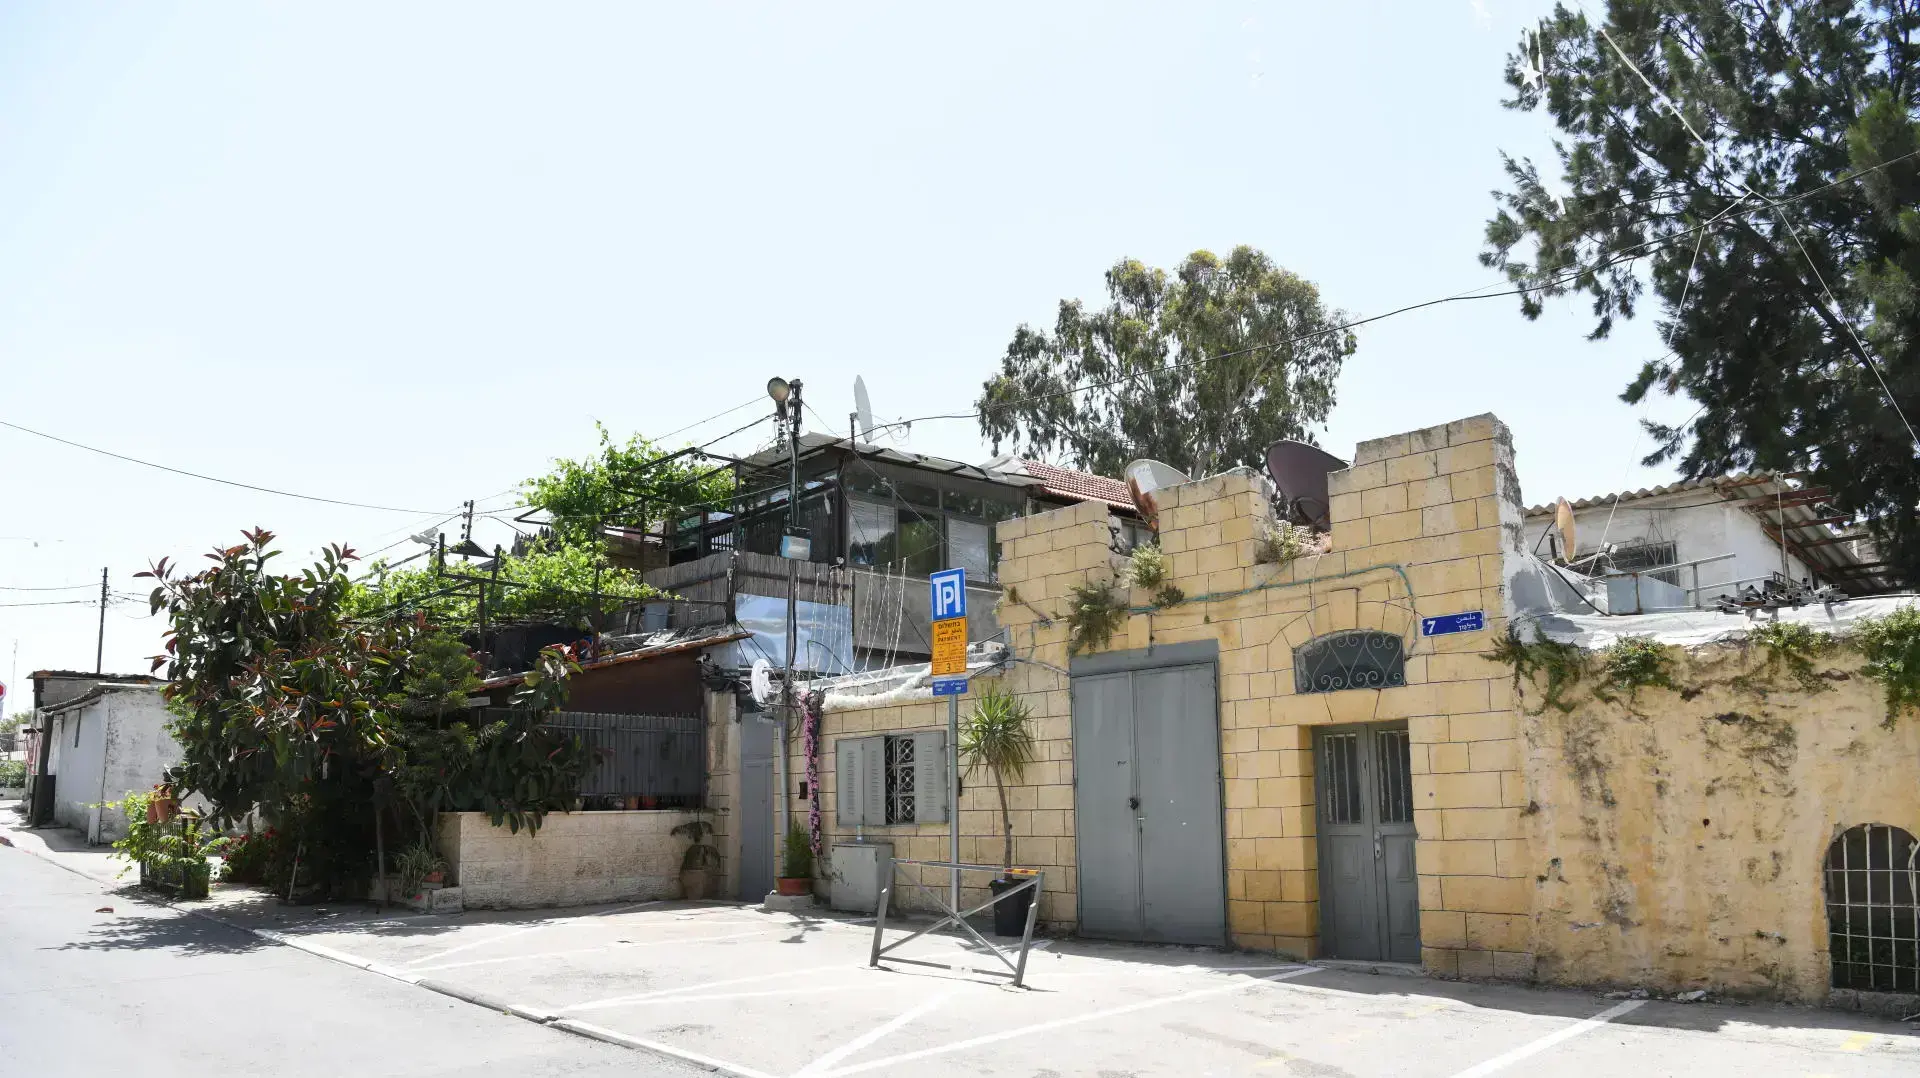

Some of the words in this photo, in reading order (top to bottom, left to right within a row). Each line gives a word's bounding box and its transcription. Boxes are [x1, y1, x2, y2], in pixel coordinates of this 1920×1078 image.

[938, 621, 961, 630] בתשלום
[1427, 620, 1436, 634] 7
[946, 662, 951, 672] 3
